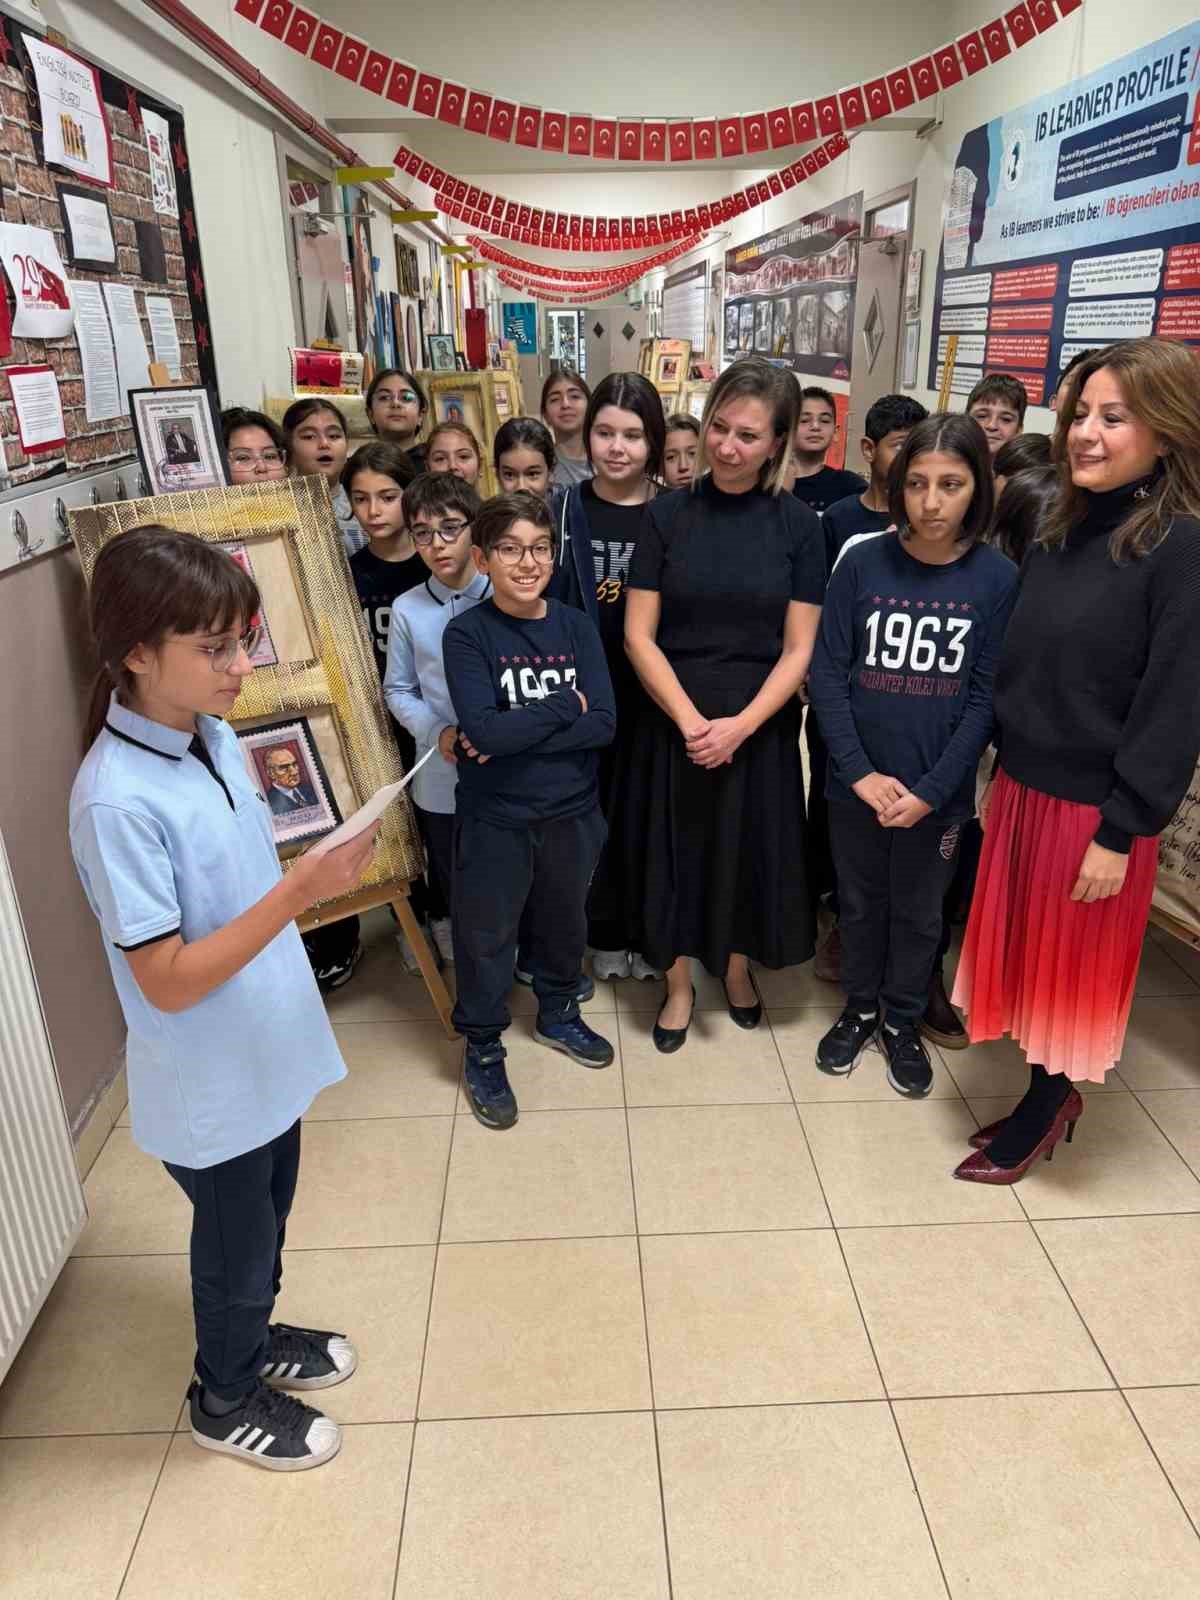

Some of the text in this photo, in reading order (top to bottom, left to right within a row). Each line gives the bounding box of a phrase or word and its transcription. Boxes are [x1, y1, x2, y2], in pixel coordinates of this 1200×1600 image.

[1035, 111, 1048, 143] IB
[1049, 81, 1113, 137] LEARNER
[1115, 46, 1191, 110] PROFILE
[1000, 225, 1008, 239] As
[1009, 221, 1016, 236] IB
[1016, 216, 1042, 235] learners
[1043, 217, 1053, 229] we
[1054, 208, 1075, 227] strive
[1076, 208, 1085, 222] to
[1086, 202, 1100, 221] be:
[1105, 199, 1116, 217] IB
[1117, 181, 1170, 218] öğrencileri
[1171, 179, 1200, 202] olara
[865, 610, 972, 674] 1963
